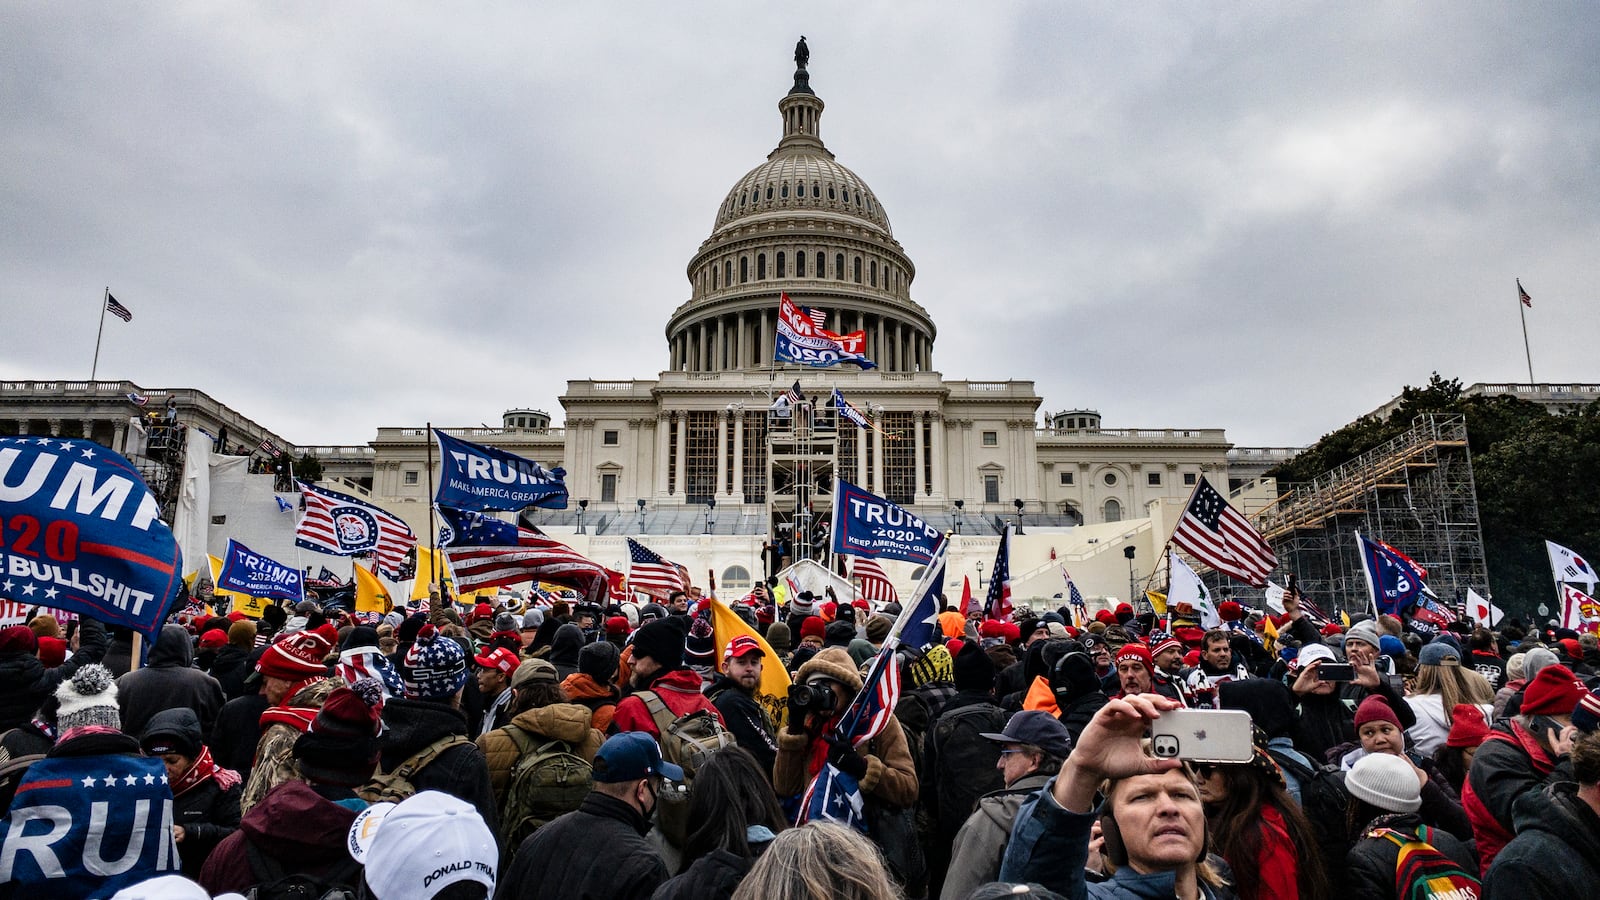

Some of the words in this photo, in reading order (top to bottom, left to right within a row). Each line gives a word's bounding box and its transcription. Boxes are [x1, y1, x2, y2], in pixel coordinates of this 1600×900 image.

[450, 450, 549, 485] TRUM
[450, 478, 470, 493] MAKE
[471, 485, 509, 499] AMERICA
[511, 491, 538, 502] GREAT
[850, 498, 938, 538] TRUMP
[0, 514, 79, 562] 20
[848, 536, 870, 546] KEEP
[872, 539, 910, 550] AMERICA
[229, 577, 245, 585] KEEP
[246, 582, 273, 590] AMERICA
[236, 550, 298, 585] TRUMP
[8, 555, 154, 616] BULLSHIT
[424, 861, 472, 888] DONALD
